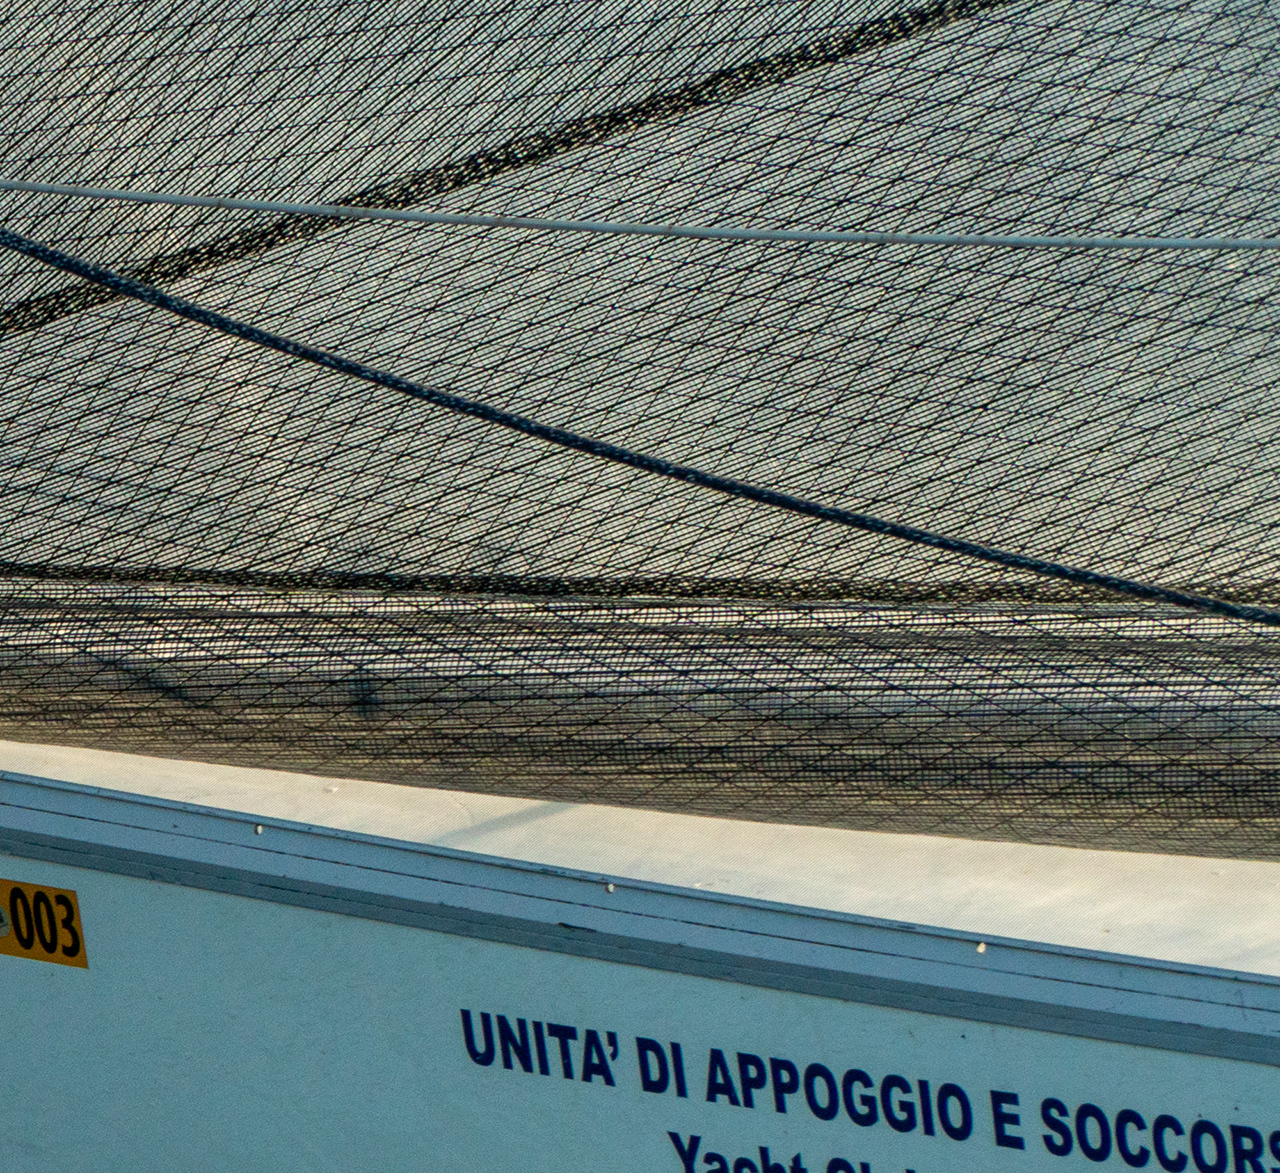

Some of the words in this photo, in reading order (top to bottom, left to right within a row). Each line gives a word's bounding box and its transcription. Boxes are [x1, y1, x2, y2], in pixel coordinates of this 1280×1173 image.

[8, 886, 82, 959] 003
[460, 1008, 619, 1087] UNITA'
[635, 1036, 688, 1099] DI
[706, 1048, 973, 1142] APPOGGIO
[989, 1089, 1025, 1151] E
